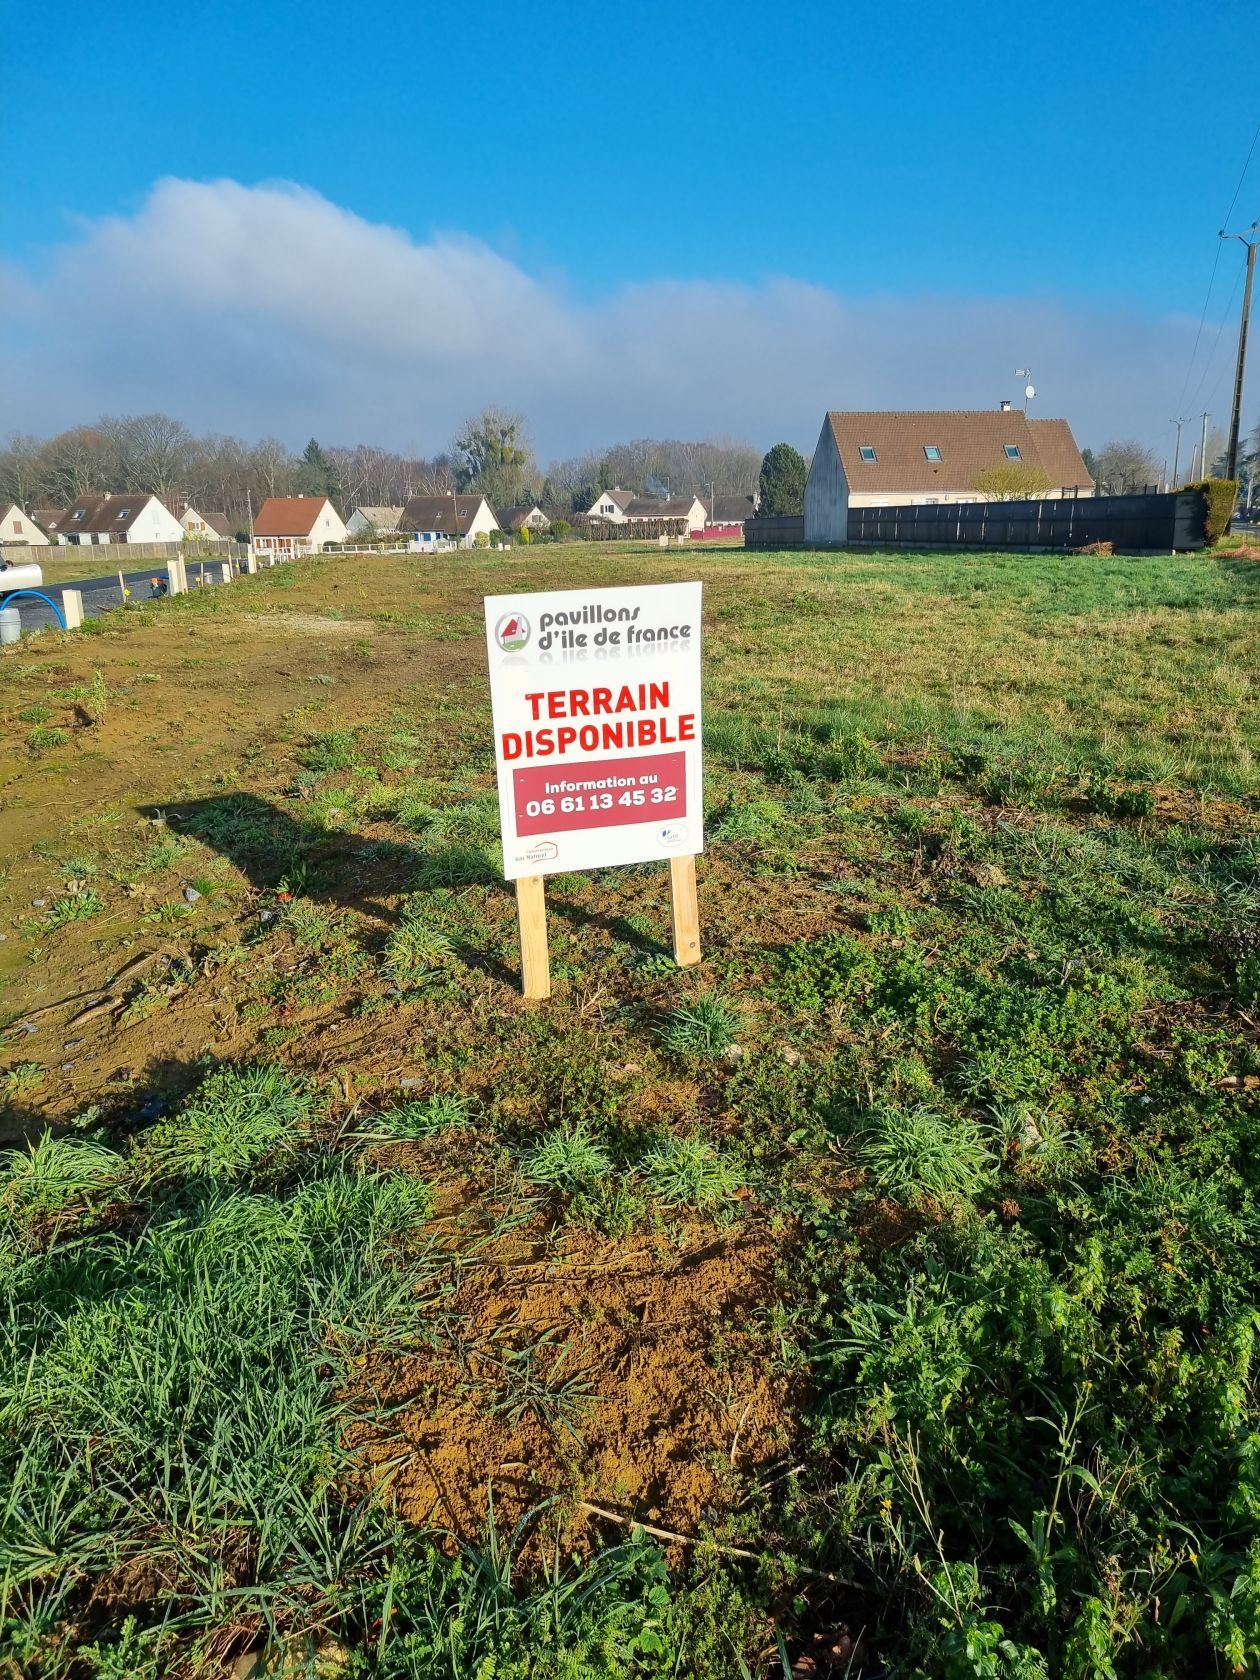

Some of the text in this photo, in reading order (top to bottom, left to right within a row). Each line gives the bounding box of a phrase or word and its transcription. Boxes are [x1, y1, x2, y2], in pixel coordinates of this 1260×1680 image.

[540, 604, 640, 632] pavillons
[594, 628, 620, 646] de
[628, 624, 691, 643] france
[525, 681, 670, 720] TERRAIN
[502, 714, 695, 760] DISPONIBLE
[545, 773, 658, 794] Information au
[526, 786, 676, 817] 06 61 13 45 32
